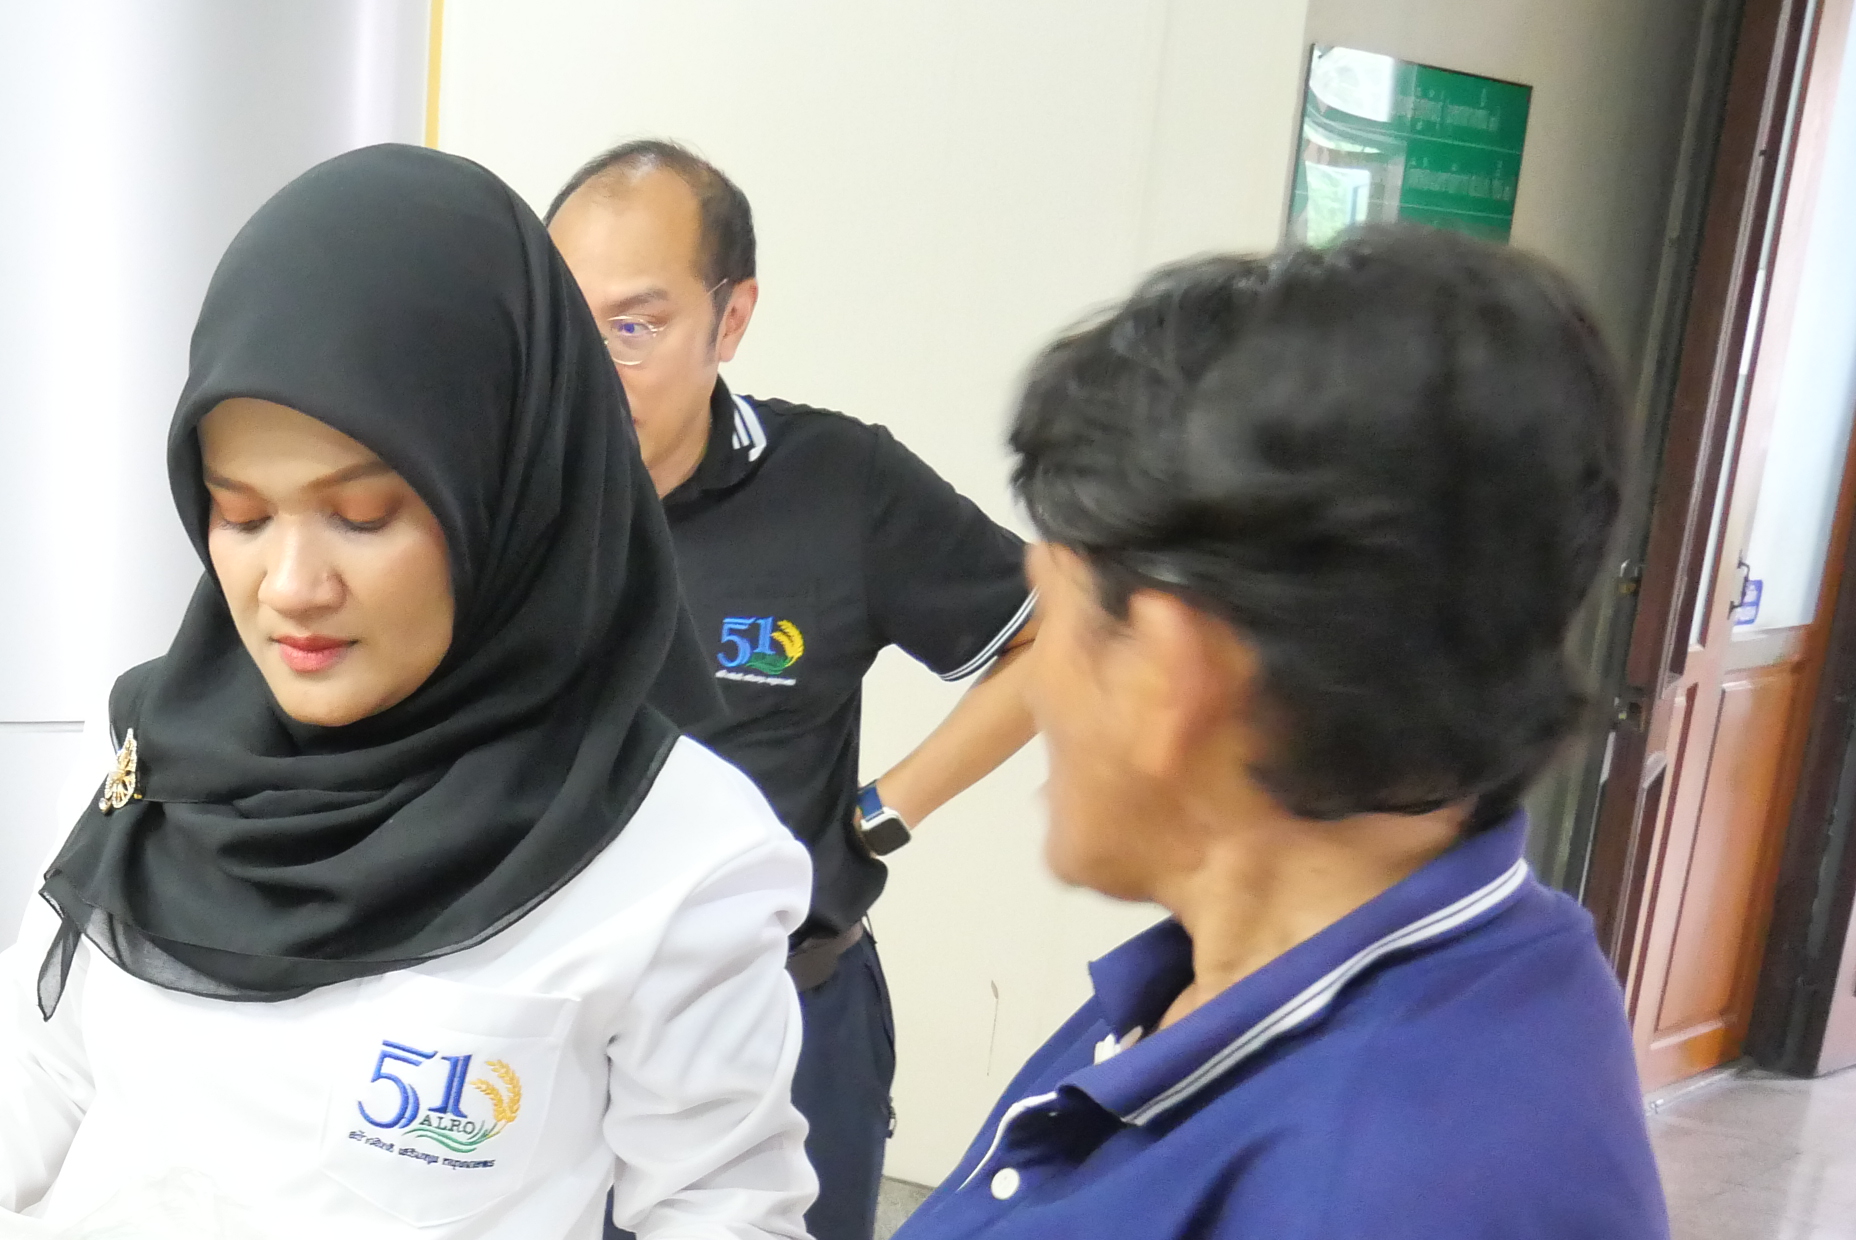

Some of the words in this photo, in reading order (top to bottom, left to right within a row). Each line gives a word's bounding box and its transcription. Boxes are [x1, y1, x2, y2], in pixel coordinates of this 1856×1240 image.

[716, 616, 776, 667] 51
[358, 1040, 472, 1129] 51
[419, 1114, 476, 1135] ALRO
